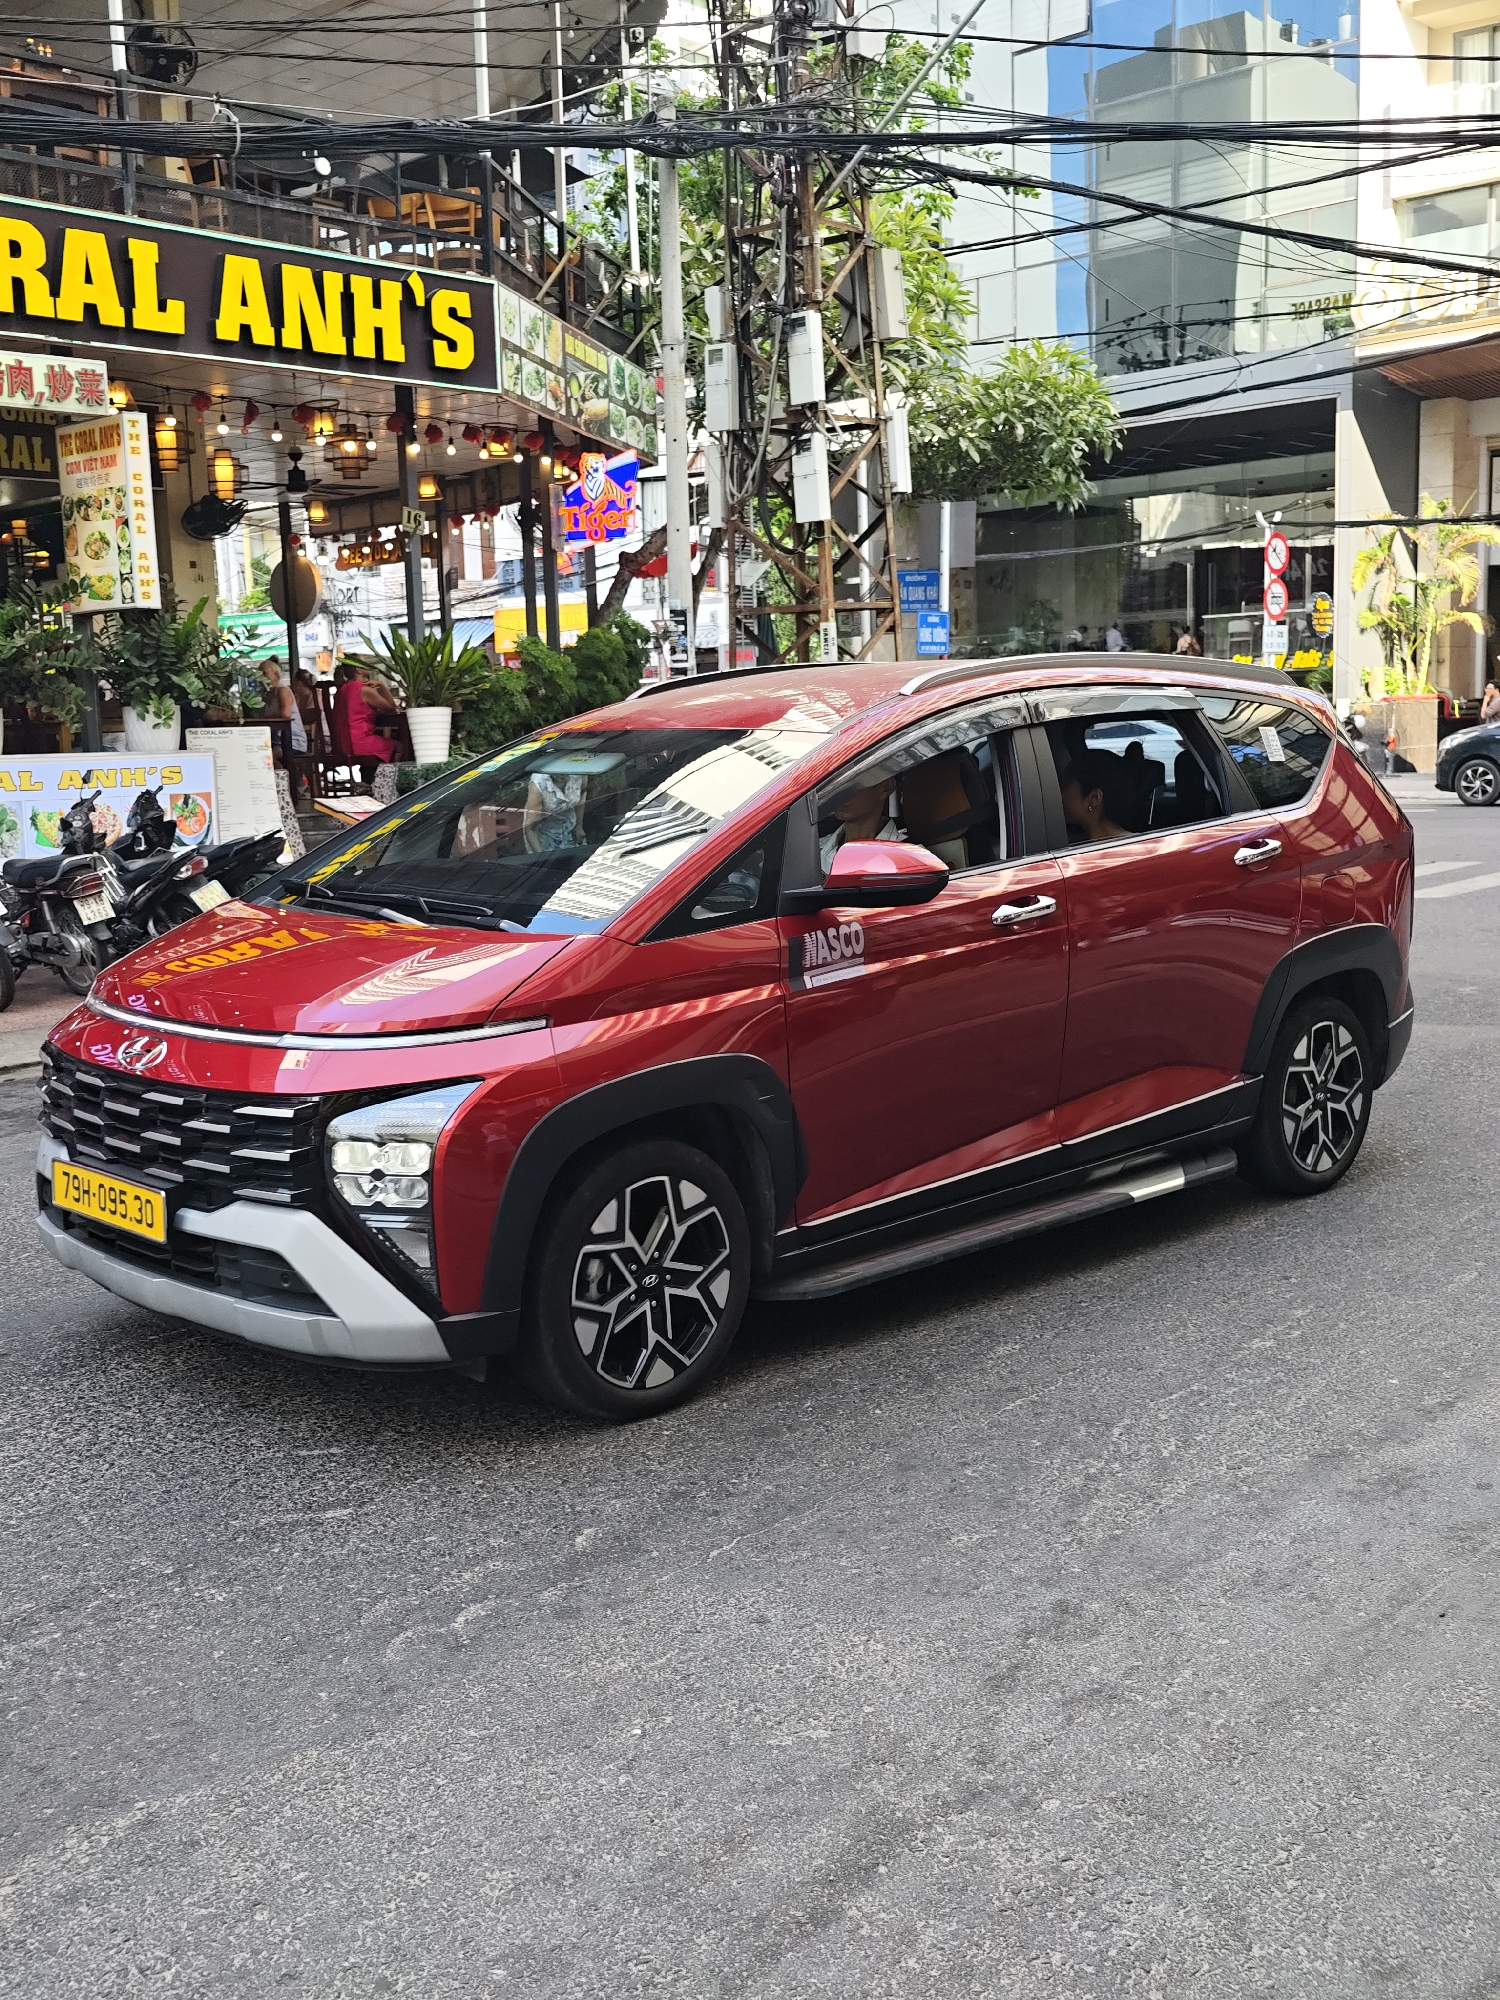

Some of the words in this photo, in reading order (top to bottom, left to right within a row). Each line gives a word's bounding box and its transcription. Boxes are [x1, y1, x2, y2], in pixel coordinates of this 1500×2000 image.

[0, 216, 186, 335] RAL
[214, 253, 476, 371] ANH'S
[0, 358, 105, 406] 肉,炒菜
[59, 433, 74, 458] THE
[74, 428, 98, 455] CORAL
[98, 423, 122, 450] ANH'S
[100, 453, 118, 470] NAM
[405, 510, 422, 527] 16
[558, 502, 635, 542] Tiger
[58, 765, 183, 791] ANH'S
[62, 1170, 154, 1229] 79H-095.30
